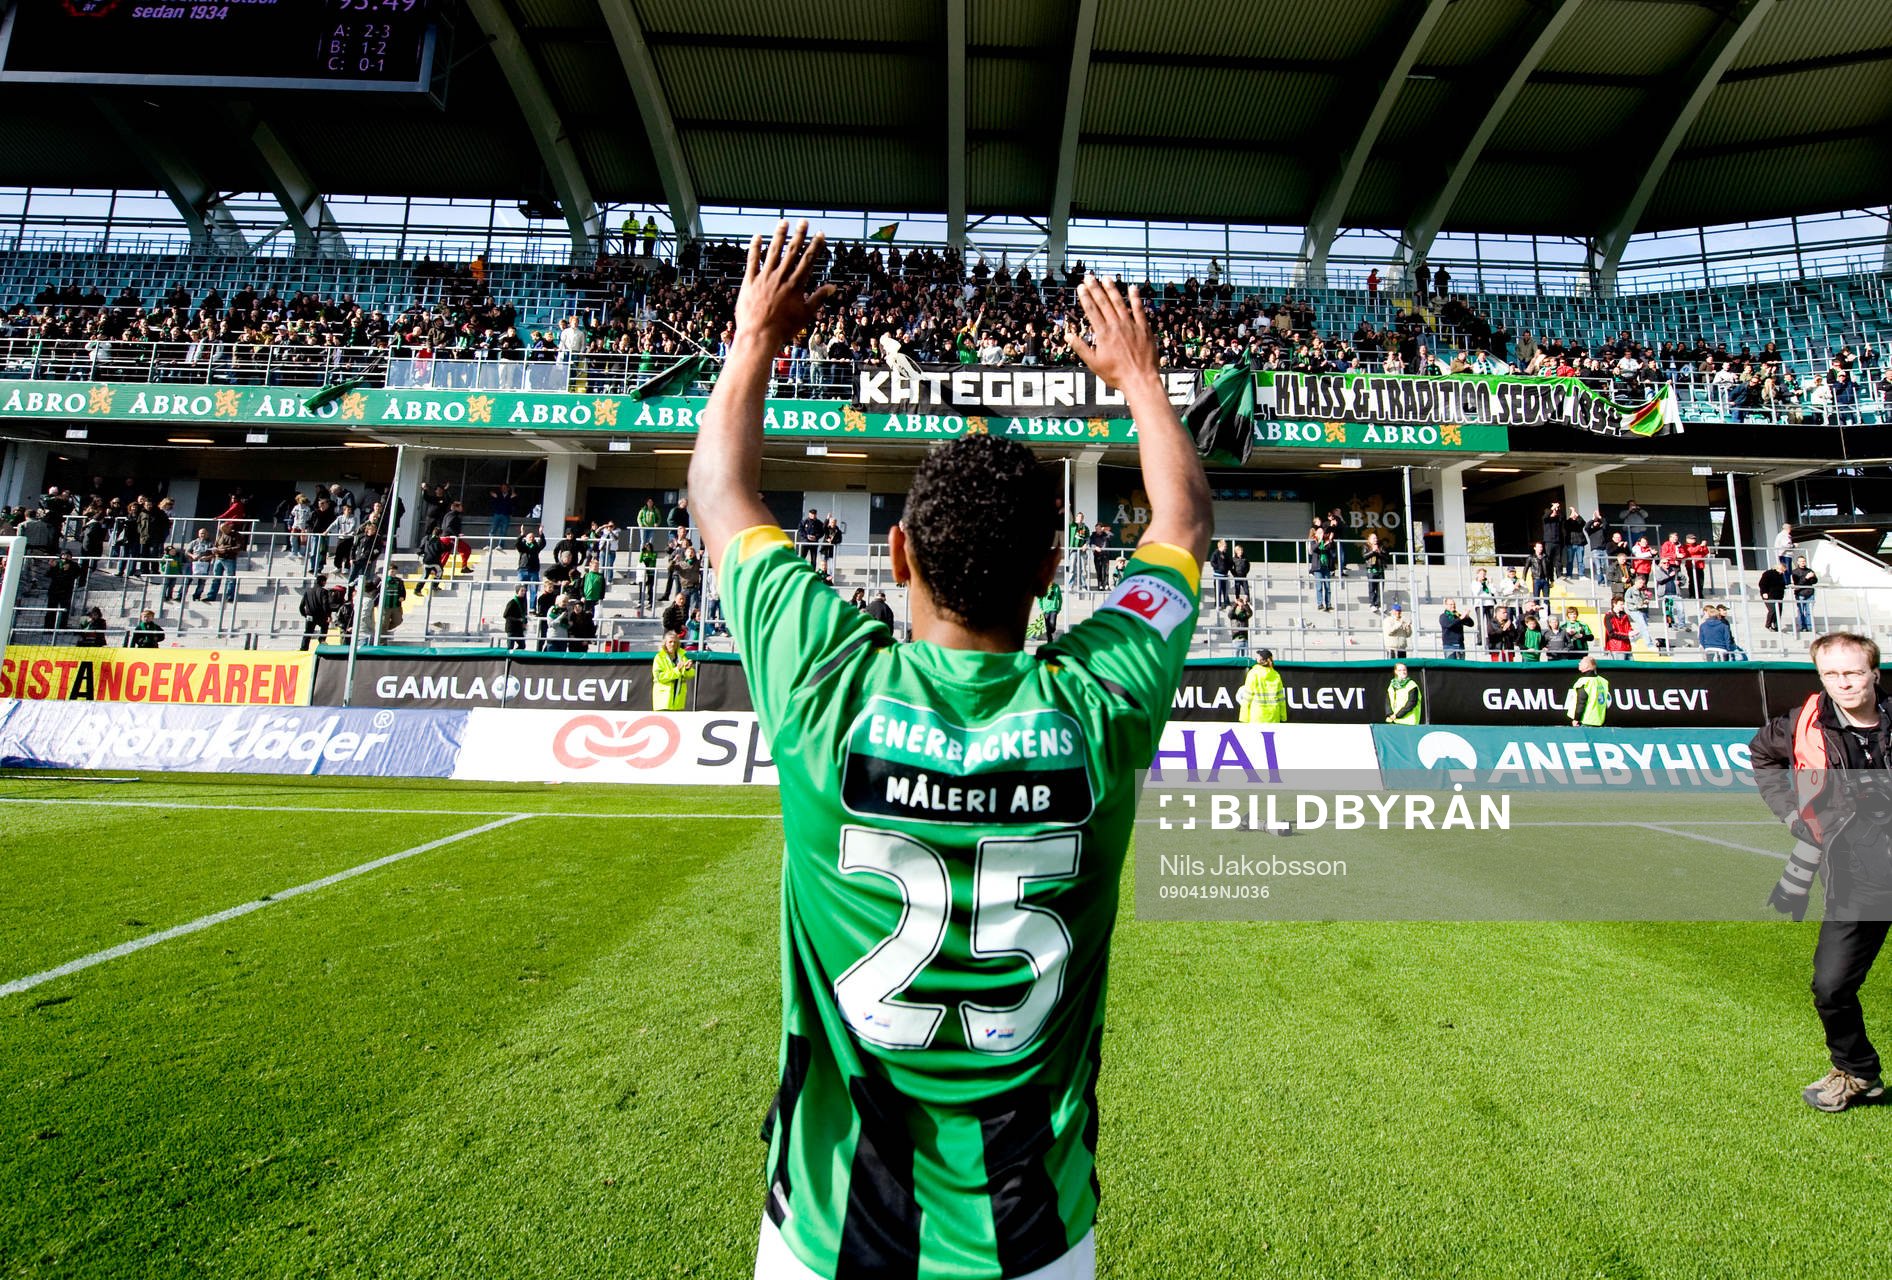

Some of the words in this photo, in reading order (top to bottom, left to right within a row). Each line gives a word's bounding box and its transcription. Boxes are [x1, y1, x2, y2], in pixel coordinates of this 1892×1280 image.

[132, 6, 183, 18] sedan
[189, 5, 229, 20] 1934
[334, 24, 351, 36] A:
[363, 24, 391, 38] 2-3
[330, 40, 346, 53] B:
[362, 41, 387, 55] 1-2
[328, 57, 345, 70] C:
[359, 57, 384, 71] 0-1
[859, 371, 1085, 406] KATEGORI
[1273, 372, 1346, 418] KLASS
[1369, 377, 1491, 425] TRADITION
[2, 389, 86, 413] ÅBRO
[129, 392, 213, 416] ÅBRO
[381, 398, 465, 423] ÅBRO
[508, 401, 591, 425] ÅBRO
[763, 407, 841, 431] ÅBRO
[1362, 423, 1437, 444] ÅBRO
[1112, 504, 1148, 524] ÅB
[1349, 511, 1400, 529] BRO
[376, 675, 488, 700] GAMLA
[524, 678, 629, 702] ULLEVI
[1171, 686, 1235, 709] MLA
[1286, 687, 1365, 710] LLEVI
[1614, 688, 1708, 711] ULLEVI
[868, 714, 1074, 768] ENERBACKENS
[885, 773, 998, 814] MÅLERI
[1010, 785, 1052, 814] AB
[834, 824, 1083, 1056] 25
